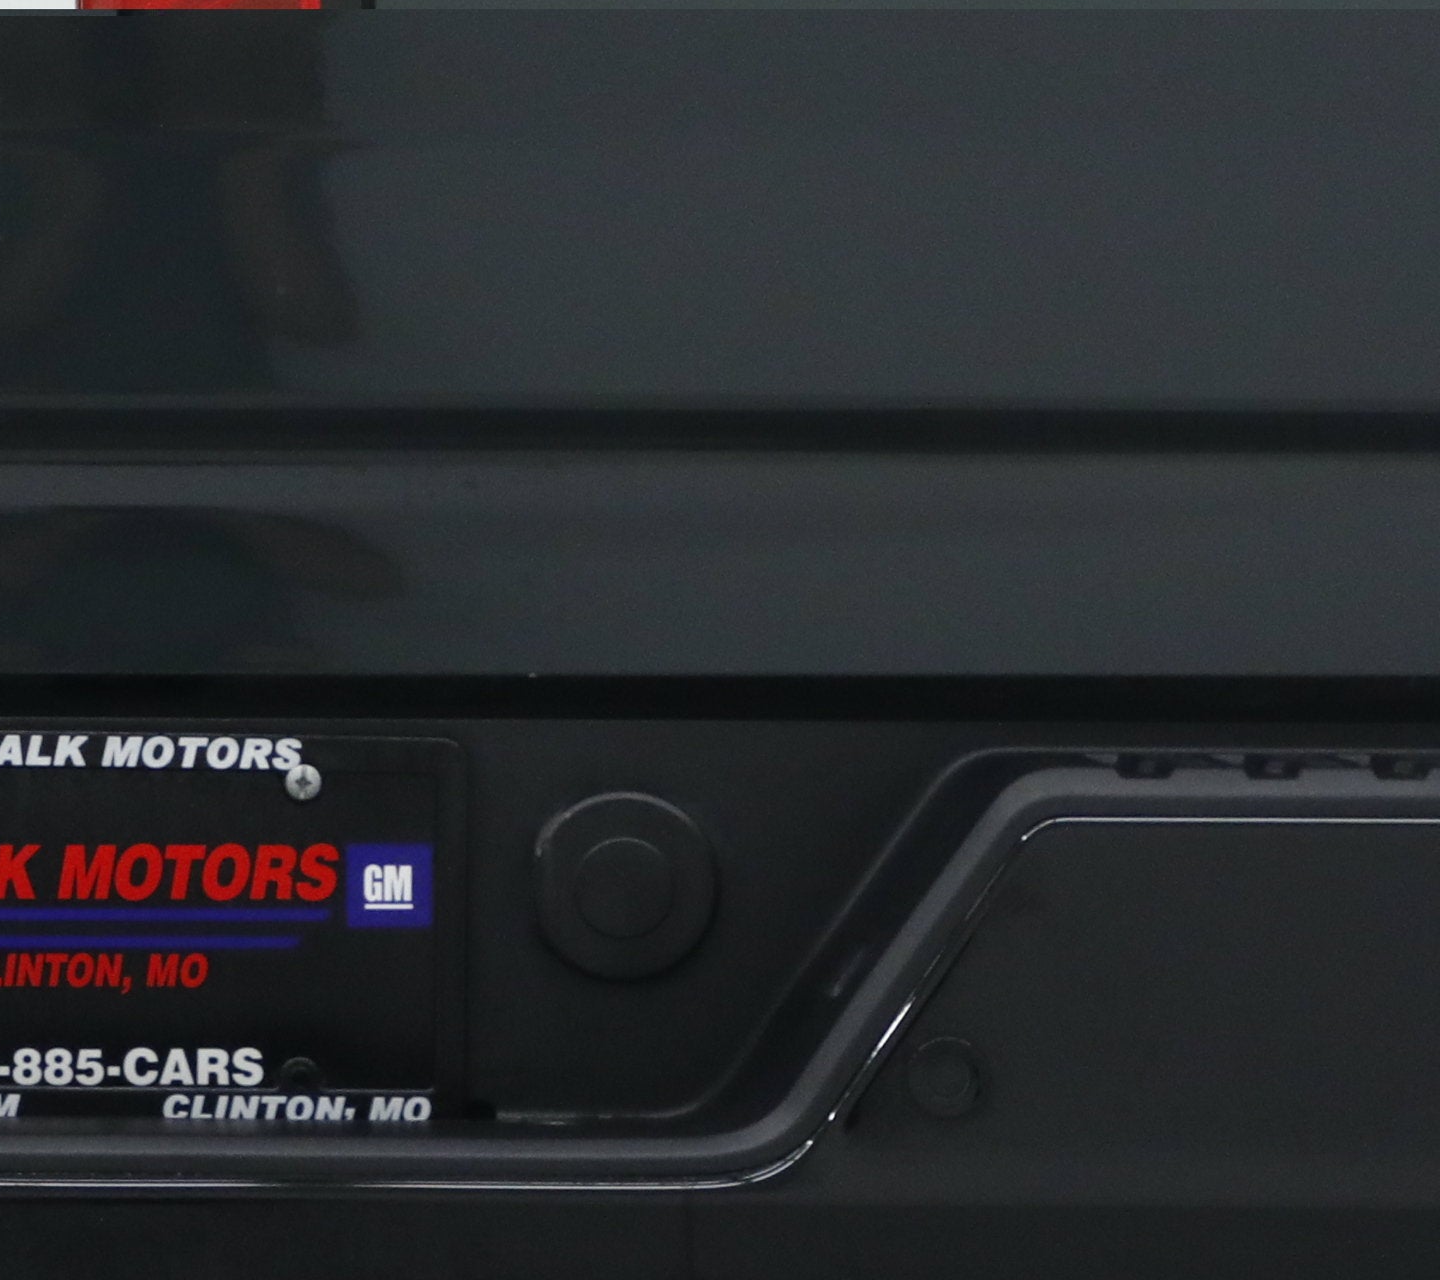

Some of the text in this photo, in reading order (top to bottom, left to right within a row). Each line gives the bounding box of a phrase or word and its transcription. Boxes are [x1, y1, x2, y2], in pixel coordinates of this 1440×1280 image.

[102, 736, 302, 772] MOTORS
[57, 844, 340, 902] MOTORS
[363, 863, 414, 904] GM
[146, 955, 210, 988] MO
[161, 1095, 432, 1124] CLINTON, MO
